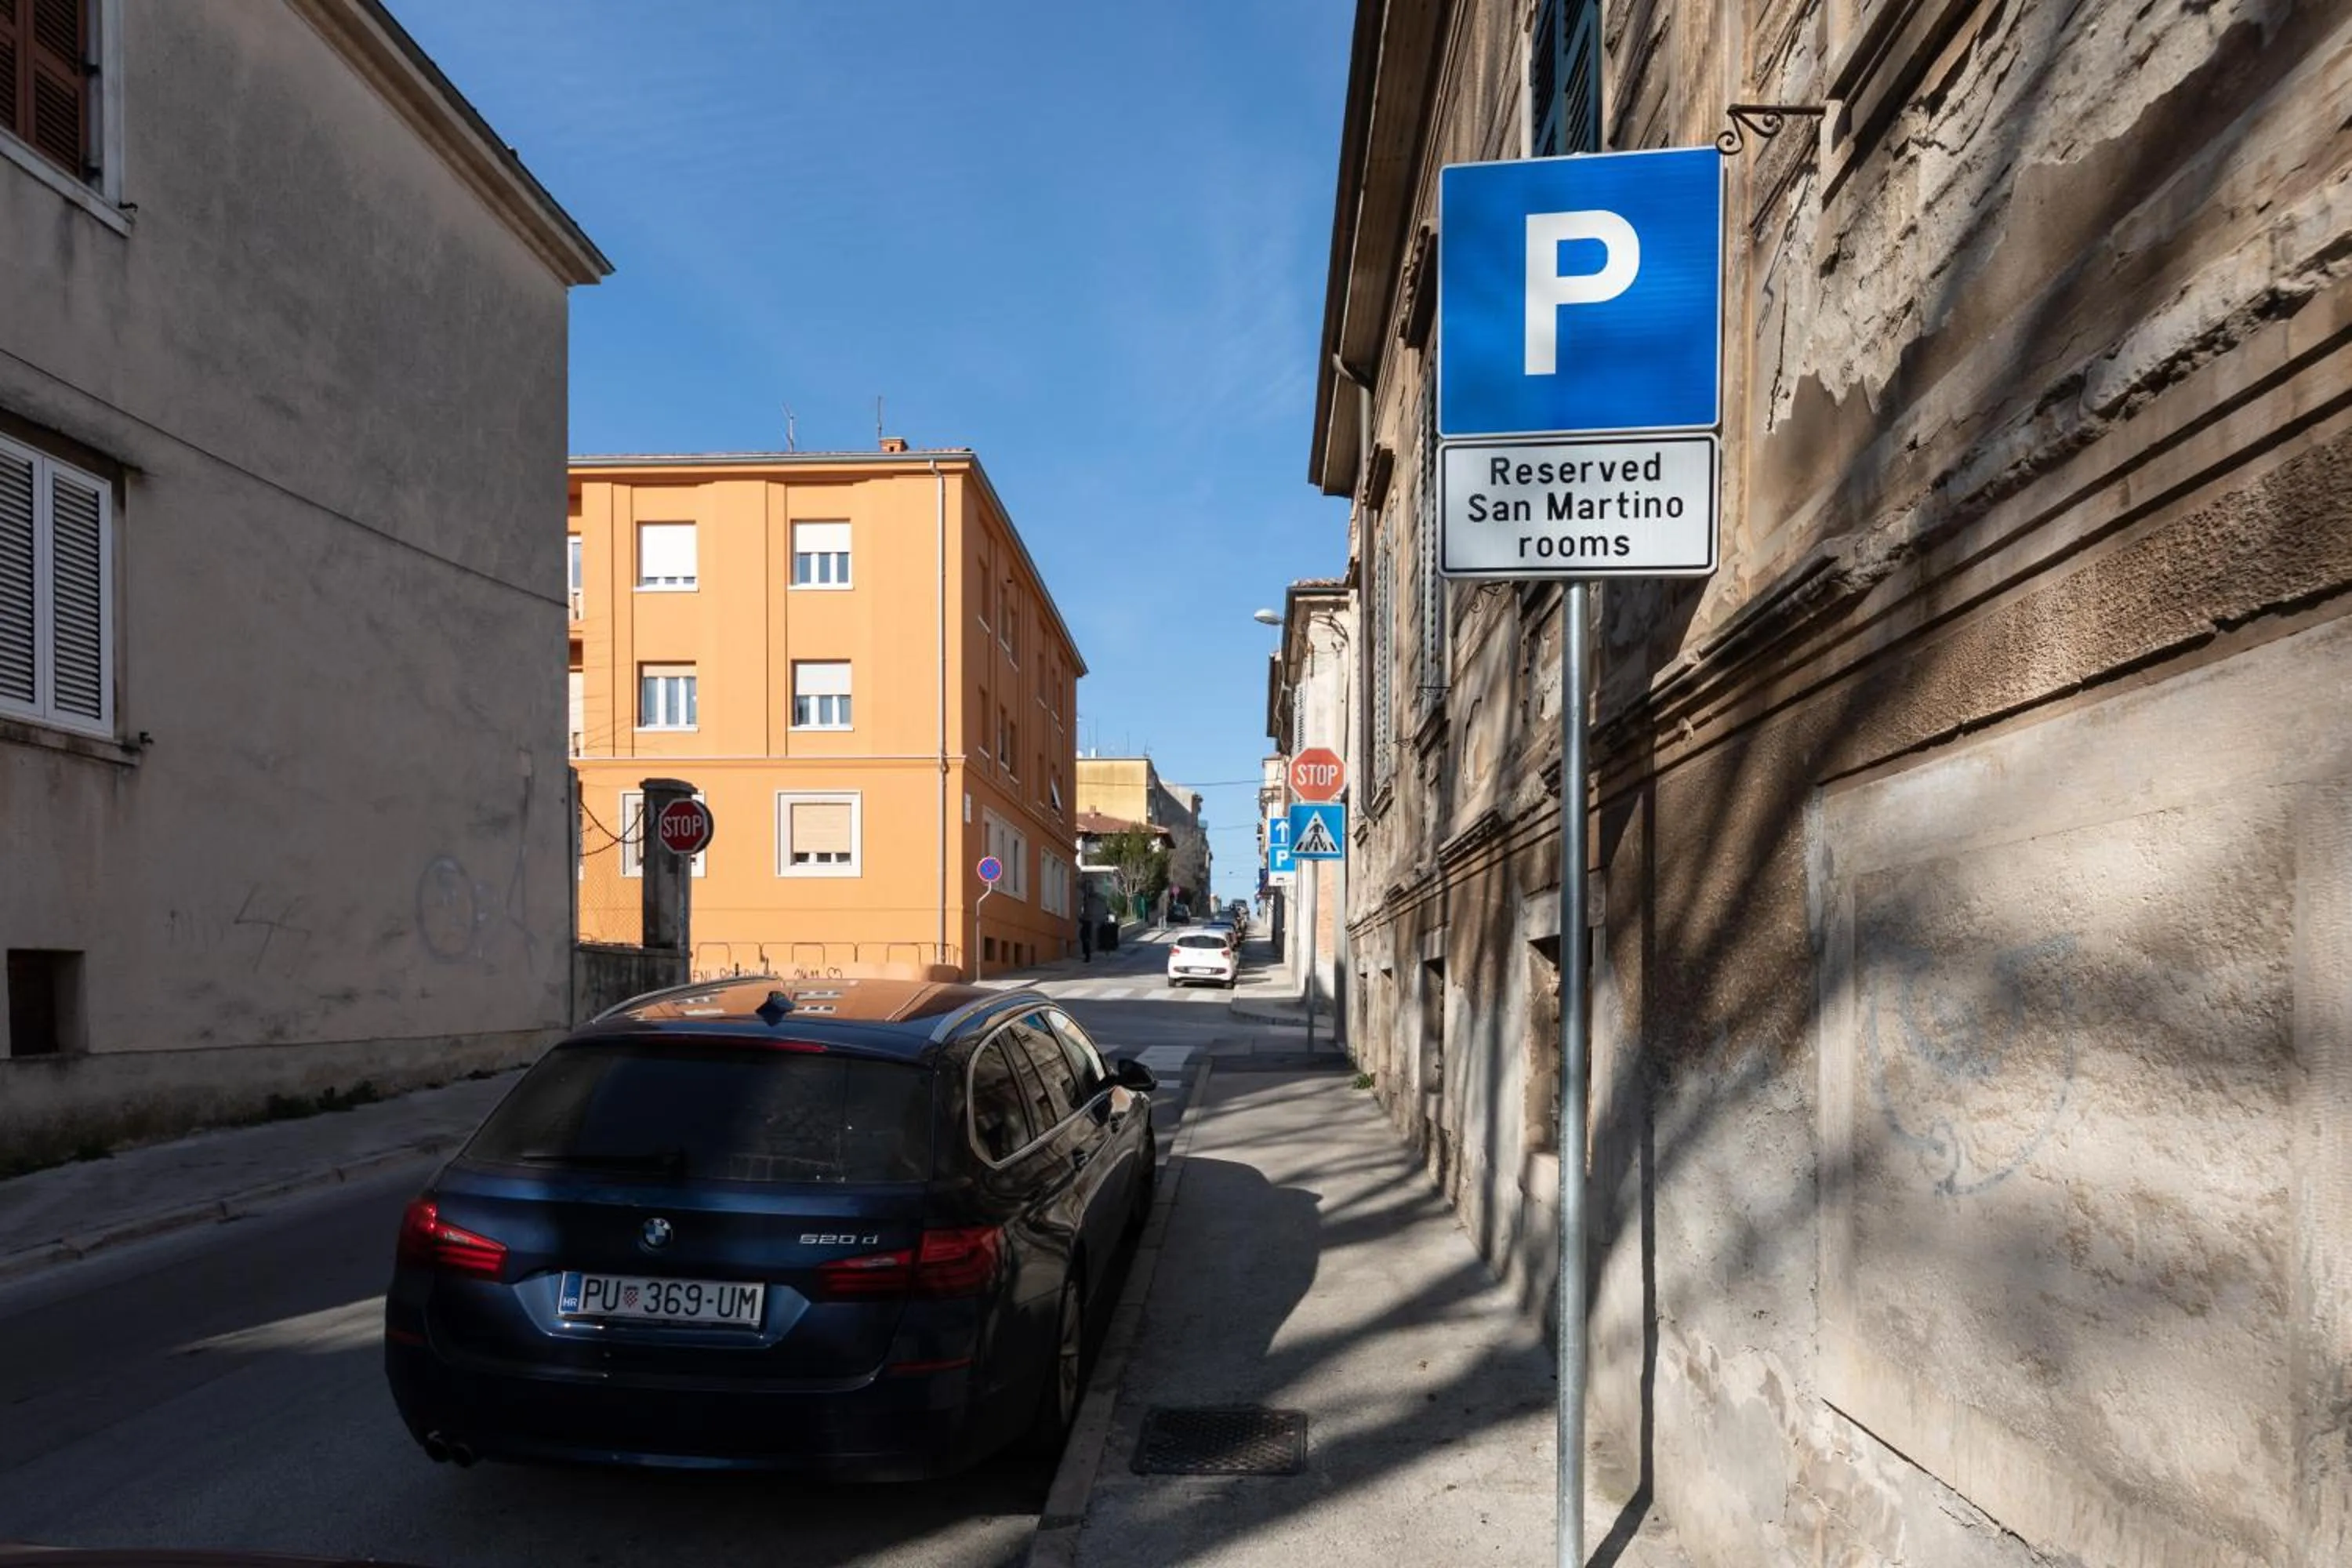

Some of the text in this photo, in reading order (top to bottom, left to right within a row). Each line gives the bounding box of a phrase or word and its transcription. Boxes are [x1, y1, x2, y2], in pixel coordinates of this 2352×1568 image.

[1525, 209, 1640, 376] P
[1490, 452, 1661, 485] Reserved
[1468, 491, 1684, 523] San Martino
[1519, 533, 1631, 557] rooms
[1297, 764, 1338, 786] STOP
[662, 815, 702, 838] STOP
[1276, 850, 1289, 867] P
[563, 1295, 579, 1308] HR
[583, 1279, 621, 1312] PU
